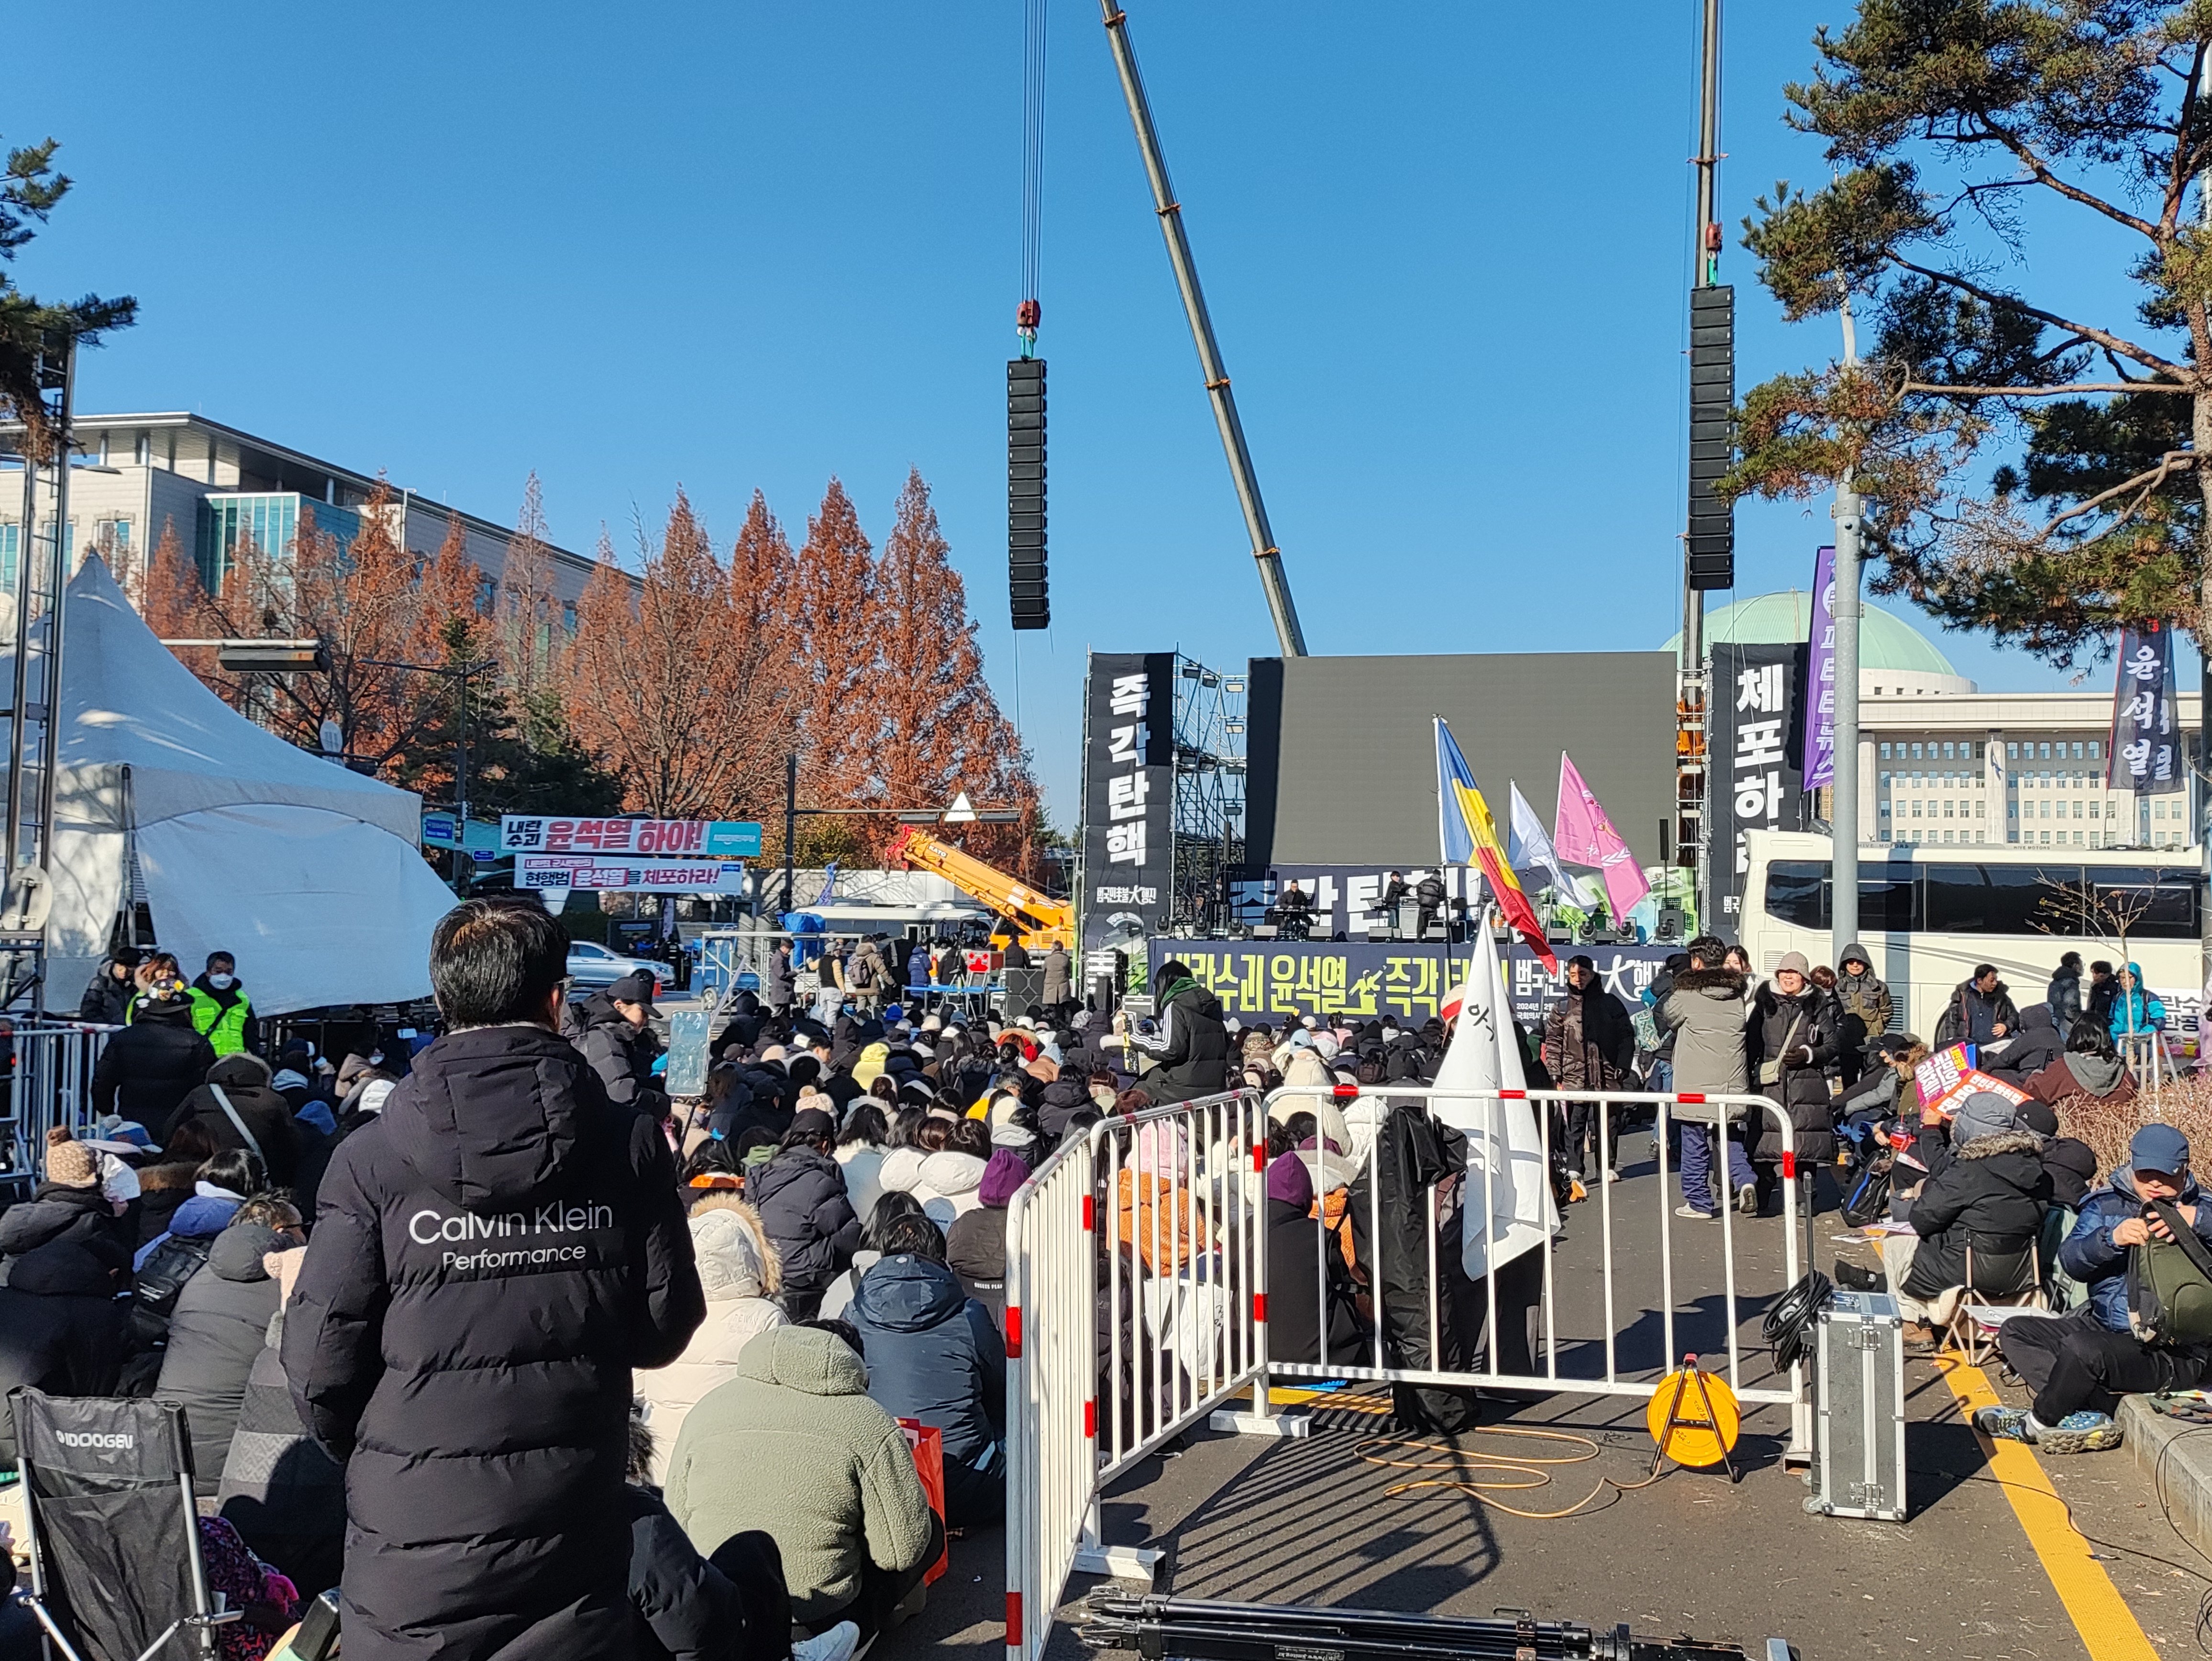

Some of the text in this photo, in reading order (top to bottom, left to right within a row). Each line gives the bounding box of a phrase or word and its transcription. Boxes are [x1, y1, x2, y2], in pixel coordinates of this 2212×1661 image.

[2121, 645, 2161, 776] 윤석열
[1106, 673, 1150, 866] 즉각탄핵
[507, 820, 542, 833] 내란
[546, 820, 704, 852] 윤석열 하야!
[506, 833, 541, 847] 수괴
[928, 845, 947, 857] KATO
[526, 872, 570, 886] 현행범
[641, 868, 720, 885] 체포하라!
[1271, 955, 1347, 1014] 윤석열
[1386, 957, 1439, 1017] 즉각
[1516, 1003, 1539, 1011] 2024년
[409, 1199, 612, 1244] Calvin Klein
[442, 1245, 586, 1271] Performance
